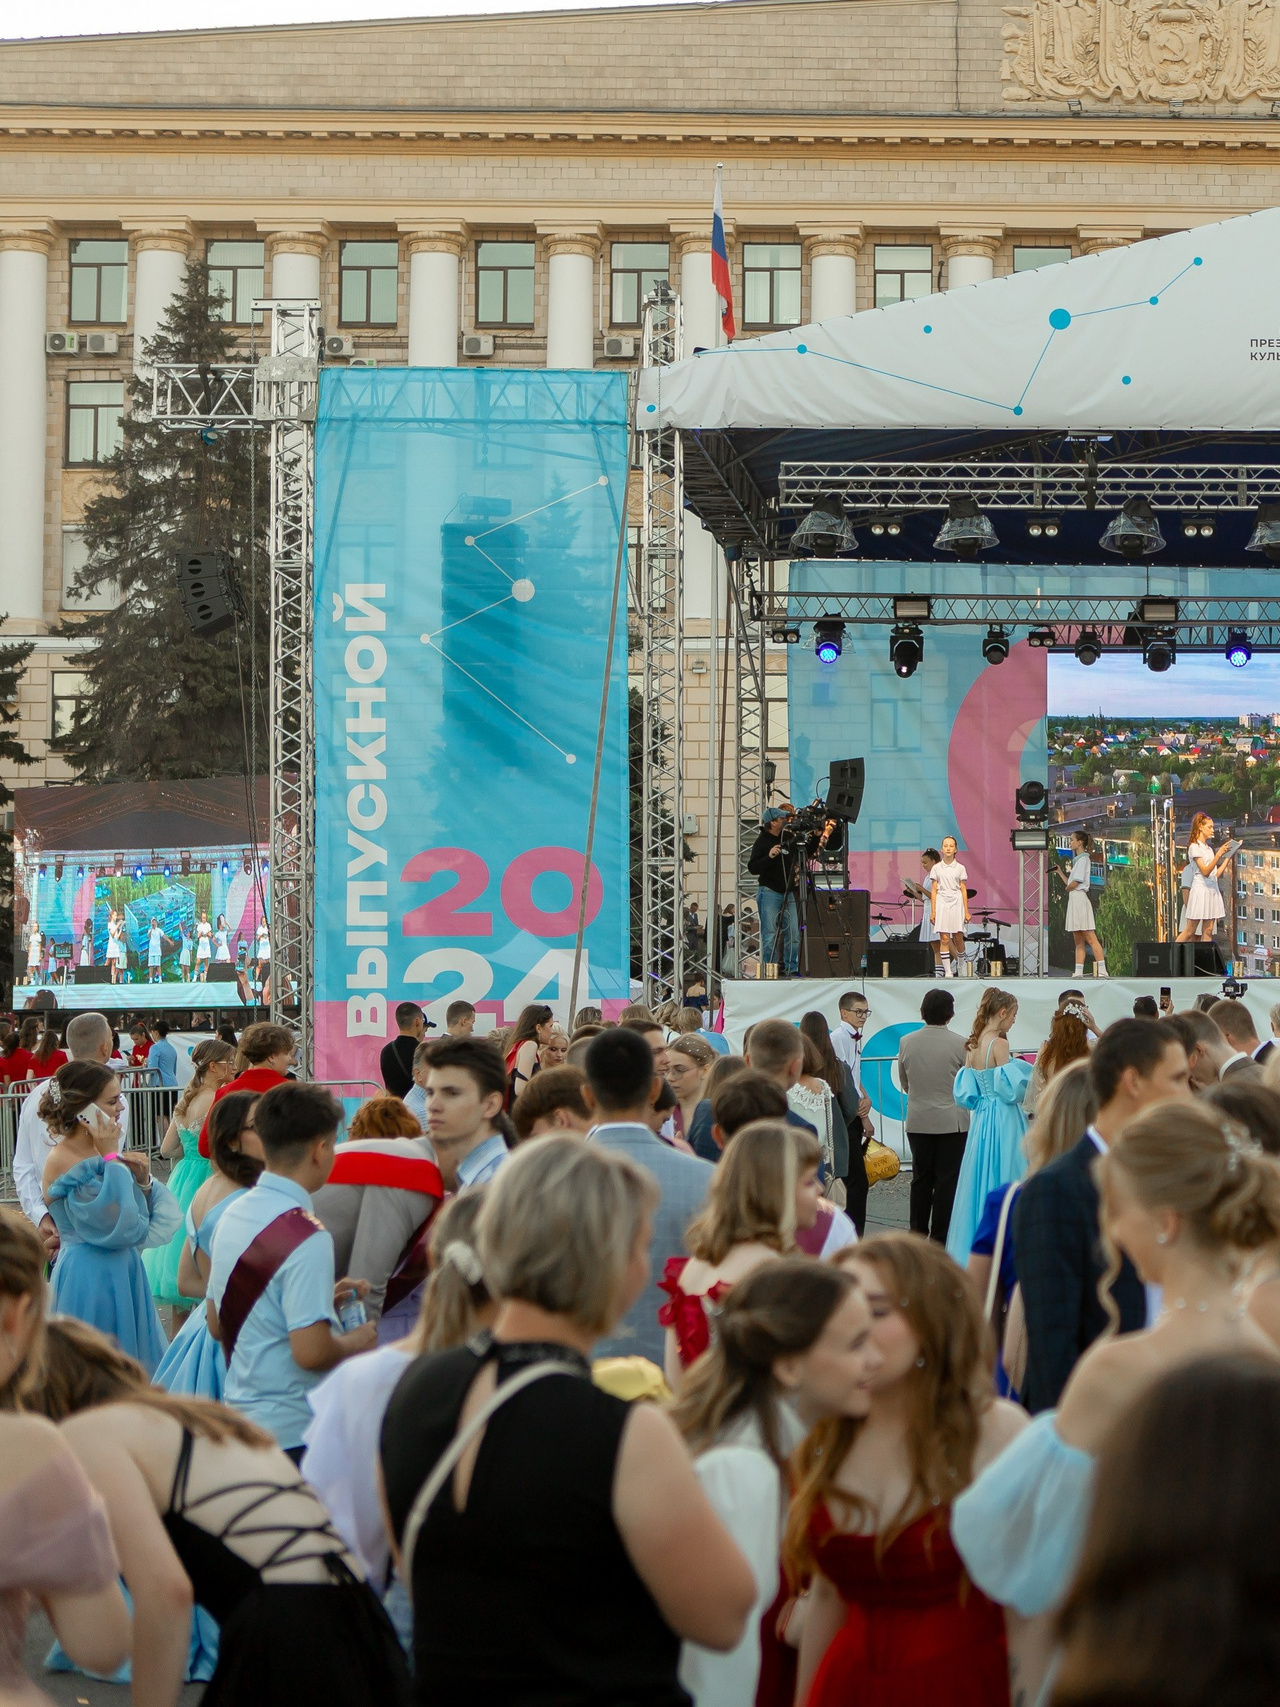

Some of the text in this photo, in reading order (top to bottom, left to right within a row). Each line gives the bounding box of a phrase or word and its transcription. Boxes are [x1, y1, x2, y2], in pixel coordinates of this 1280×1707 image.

[333, 583, 389, 1038] ВЫПУСКНОЙ
[400, 846, 604, 938] 20
[402, 947, 601, 1038] 24
